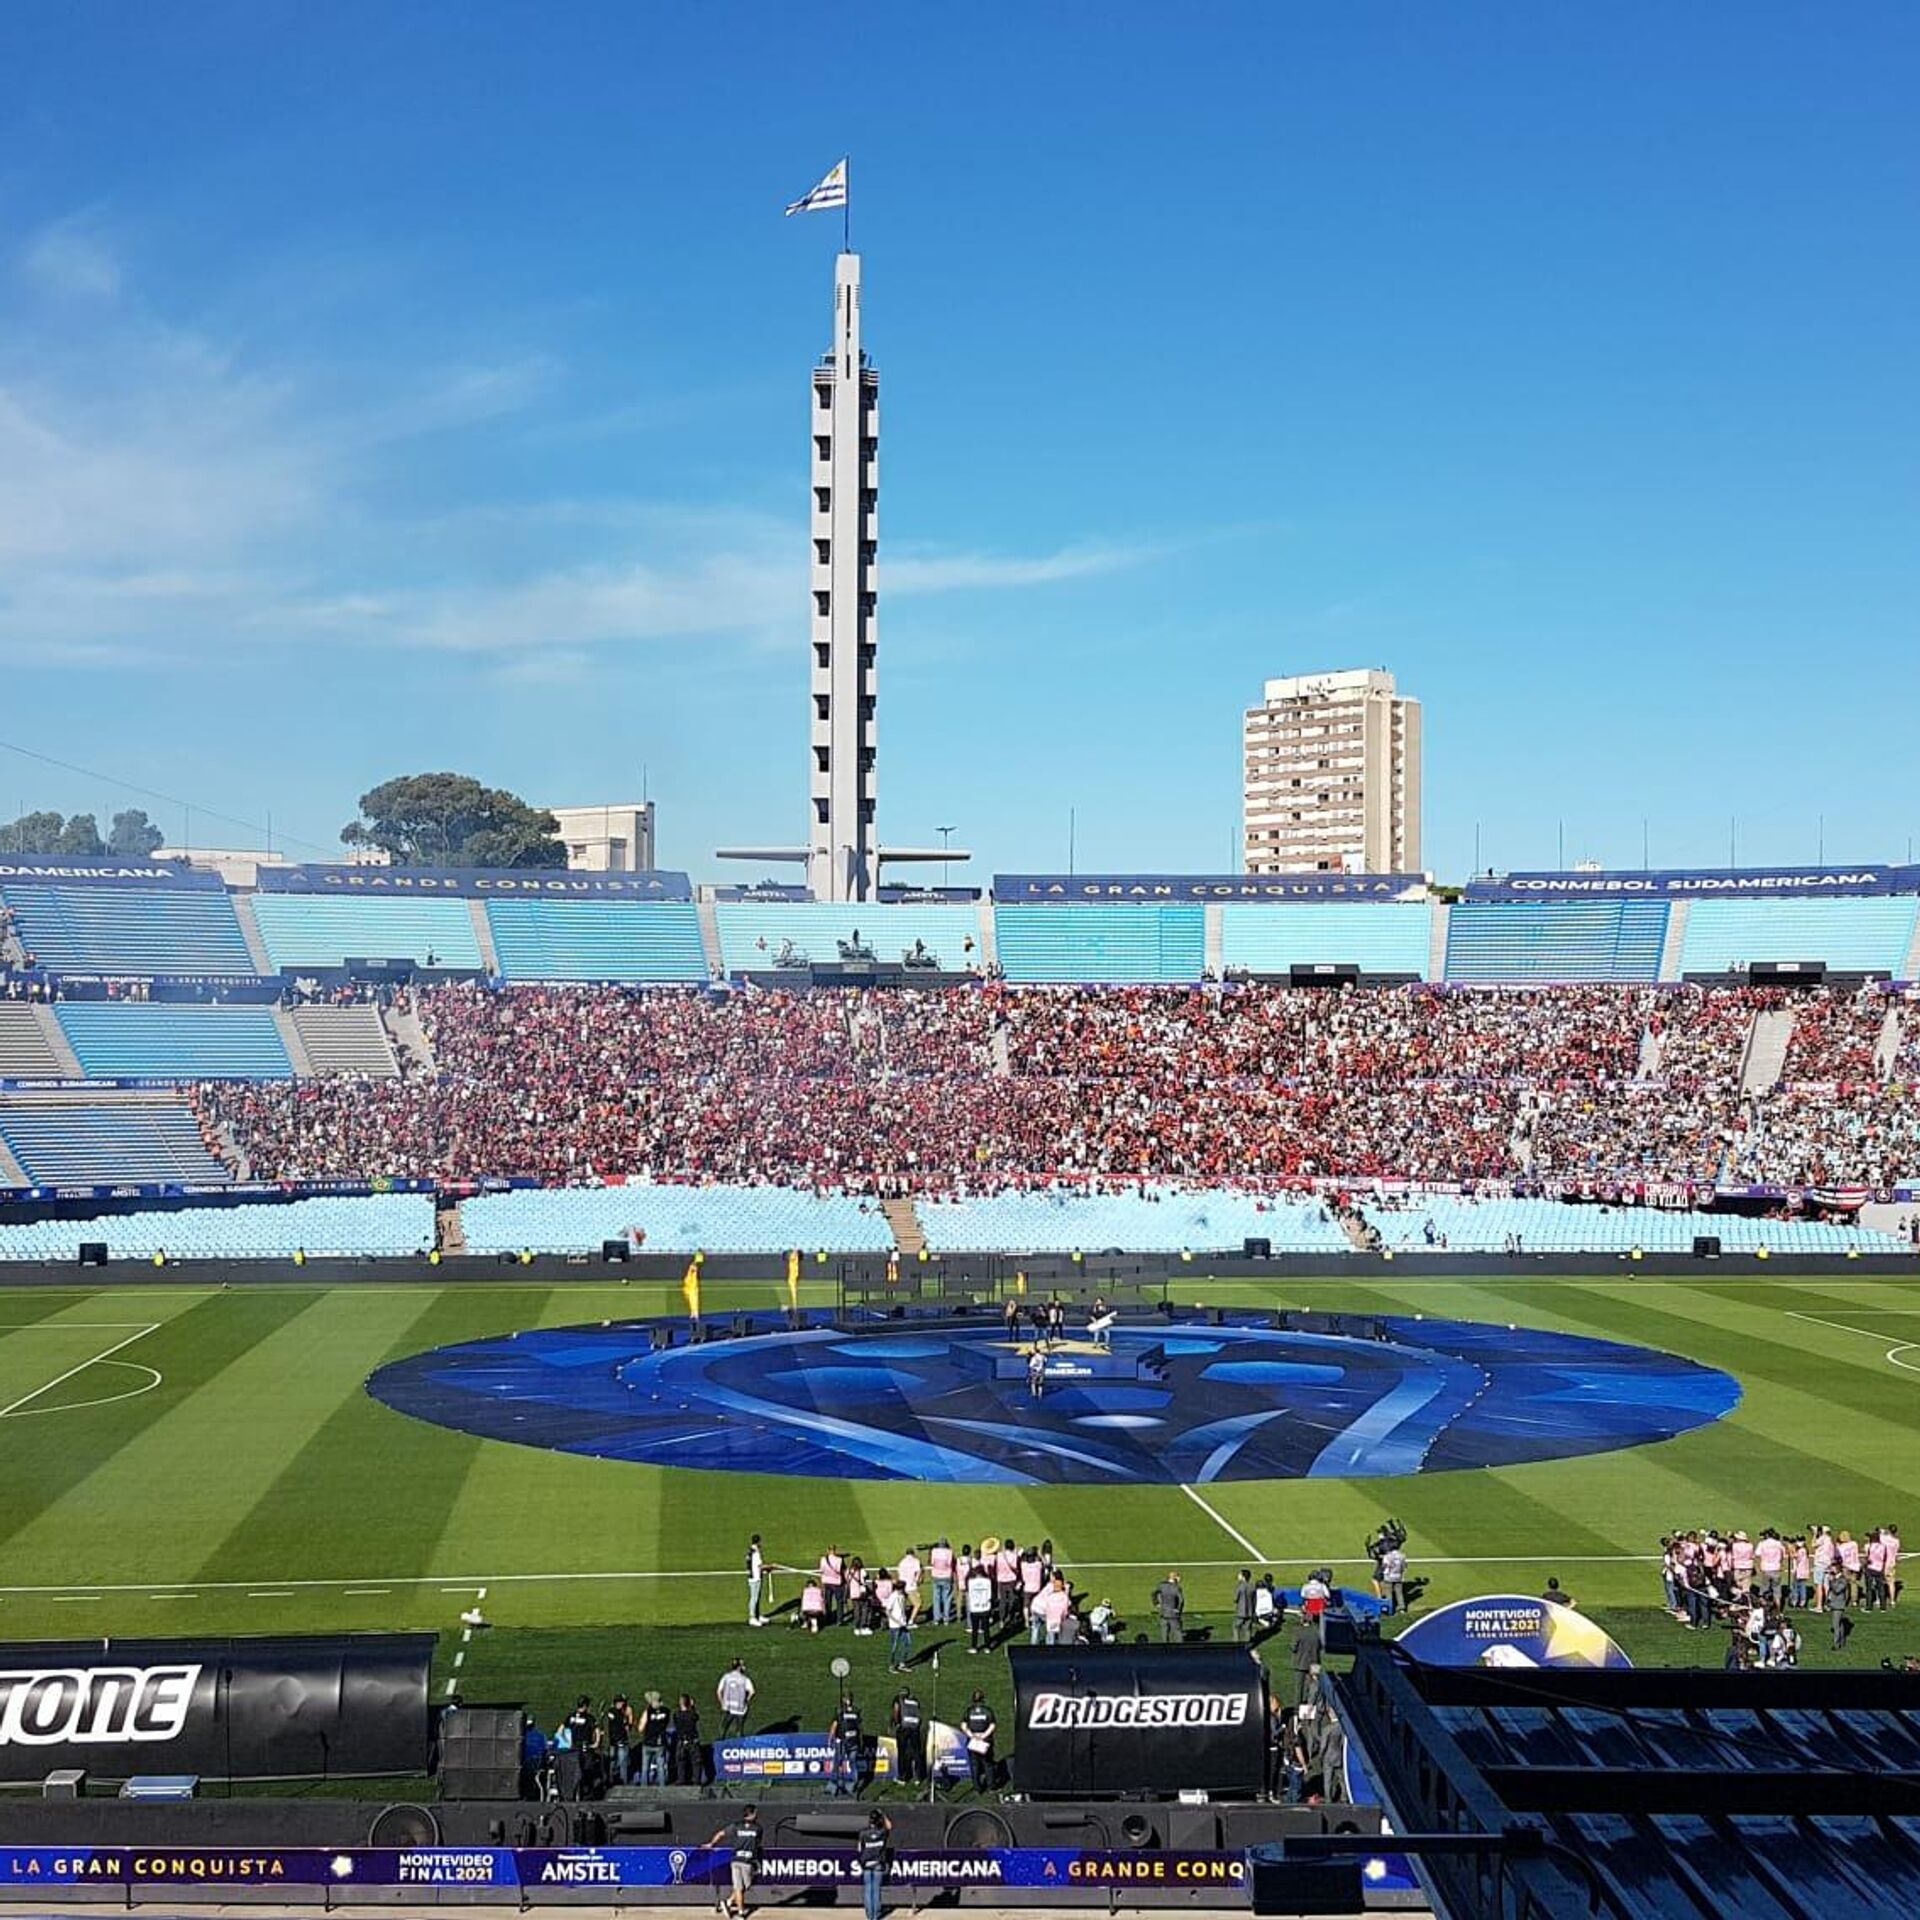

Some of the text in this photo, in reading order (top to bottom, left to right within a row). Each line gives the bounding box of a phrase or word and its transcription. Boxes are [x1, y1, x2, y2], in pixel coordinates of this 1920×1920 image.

[324, 875, 458, 889] GRANDE
[474, 880, 664, 890] CONQUISTA
[1029, 881, 1393, 896] LA GRAN CONQUISTA
[1510, 873, 1879, 891] CONMEBOL SUDAMERICANA
[1465, 1609, 1541, 1620] MONTEVIDEO
[1465, 1620, 1541, 1632] FINAL2021
[1028, 1693, 1248, 1729] BRIDGESTONE
[722, 1748, 791, 1760] CONMEBOL
[12, 1858, 285, 1877] LA GRAN CONQUISTA
[399, 1853, 494, 1867] MONTEVIDEO
[757, 1858, 1002, 1877] NMEBOL SAMERICANA
[399, 1867, 494, 1881] FINAL2021
[541, 1862, 621, 1881] AMSTEL
[1043, 1861, 1057, 1877] A
[1068, 1861, 1165, 1878] GRANDE
